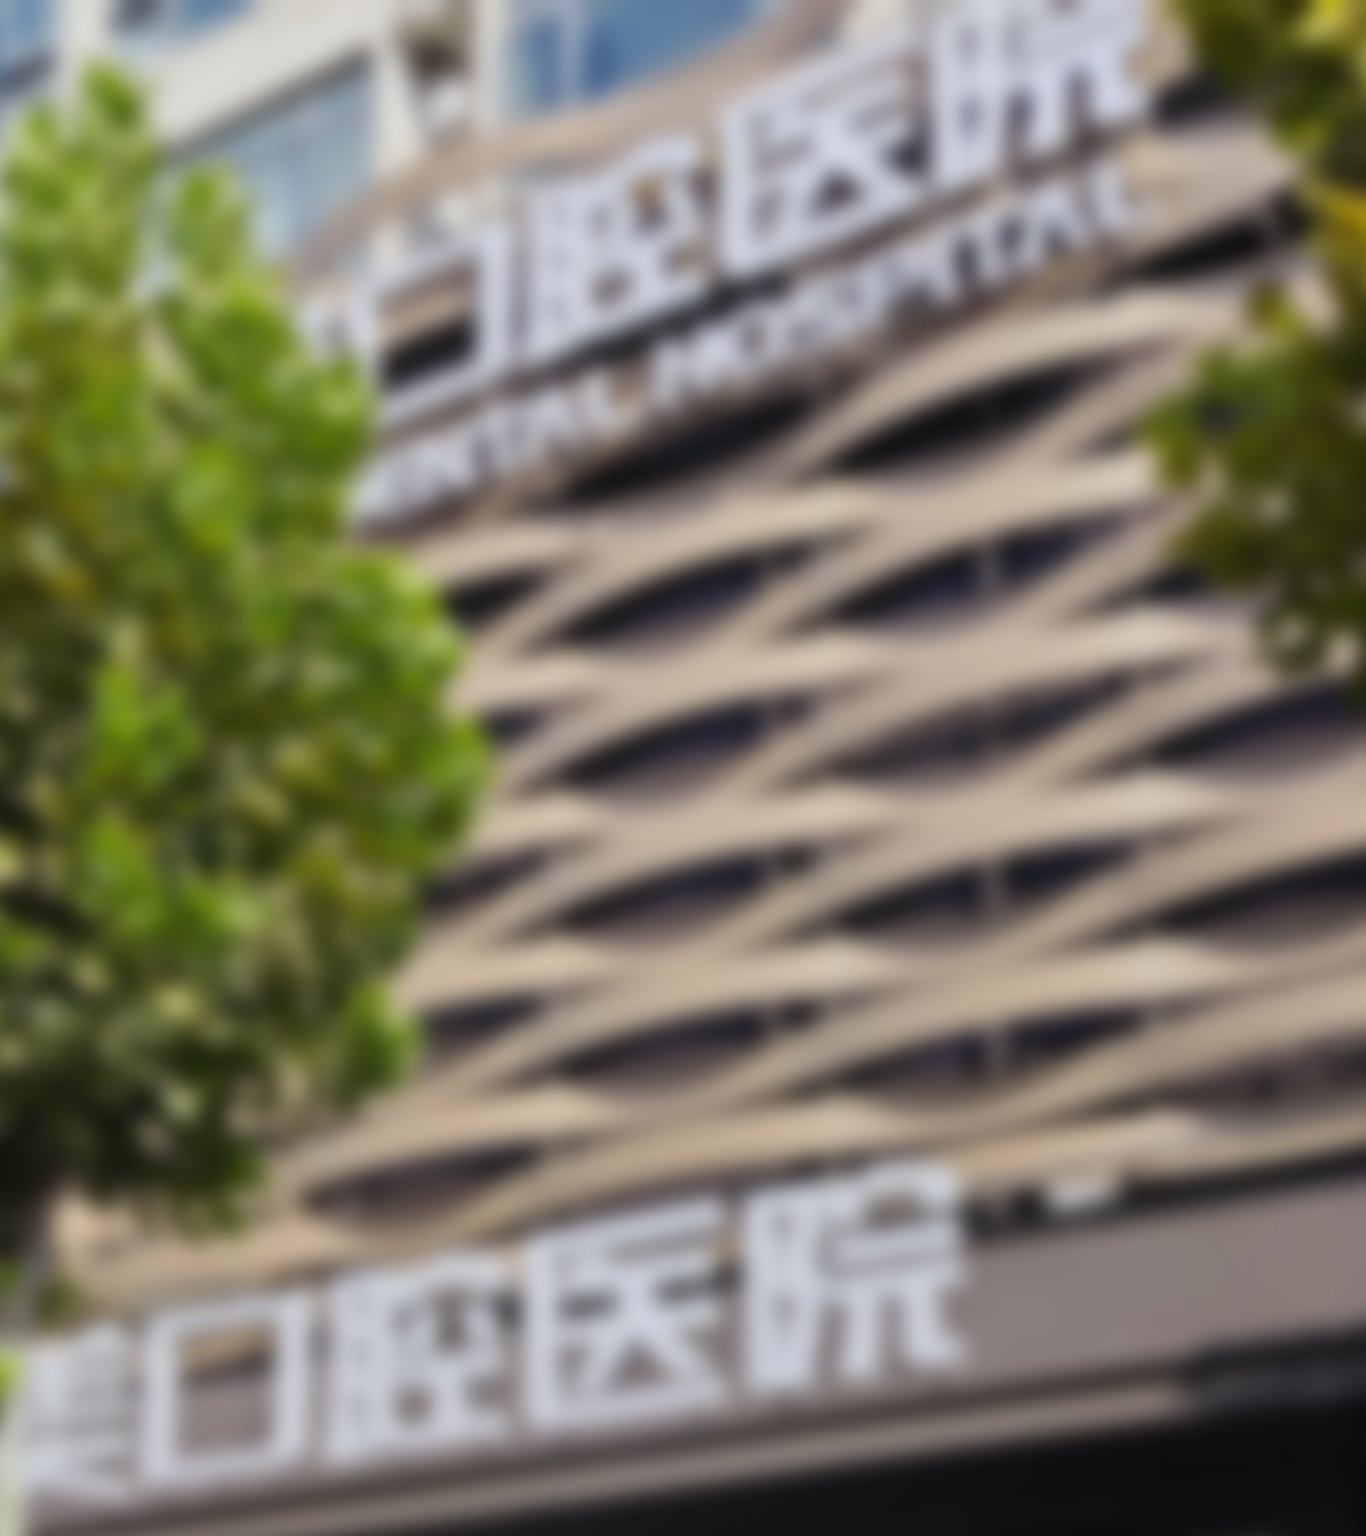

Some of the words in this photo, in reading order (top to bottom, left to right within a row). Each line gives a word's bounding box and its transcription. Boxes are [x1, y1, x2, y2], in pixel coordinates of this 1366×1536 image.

[300, 0, 1151, 424] 口腔医院
[649, 160, 1153, 408] HOSPITAL
